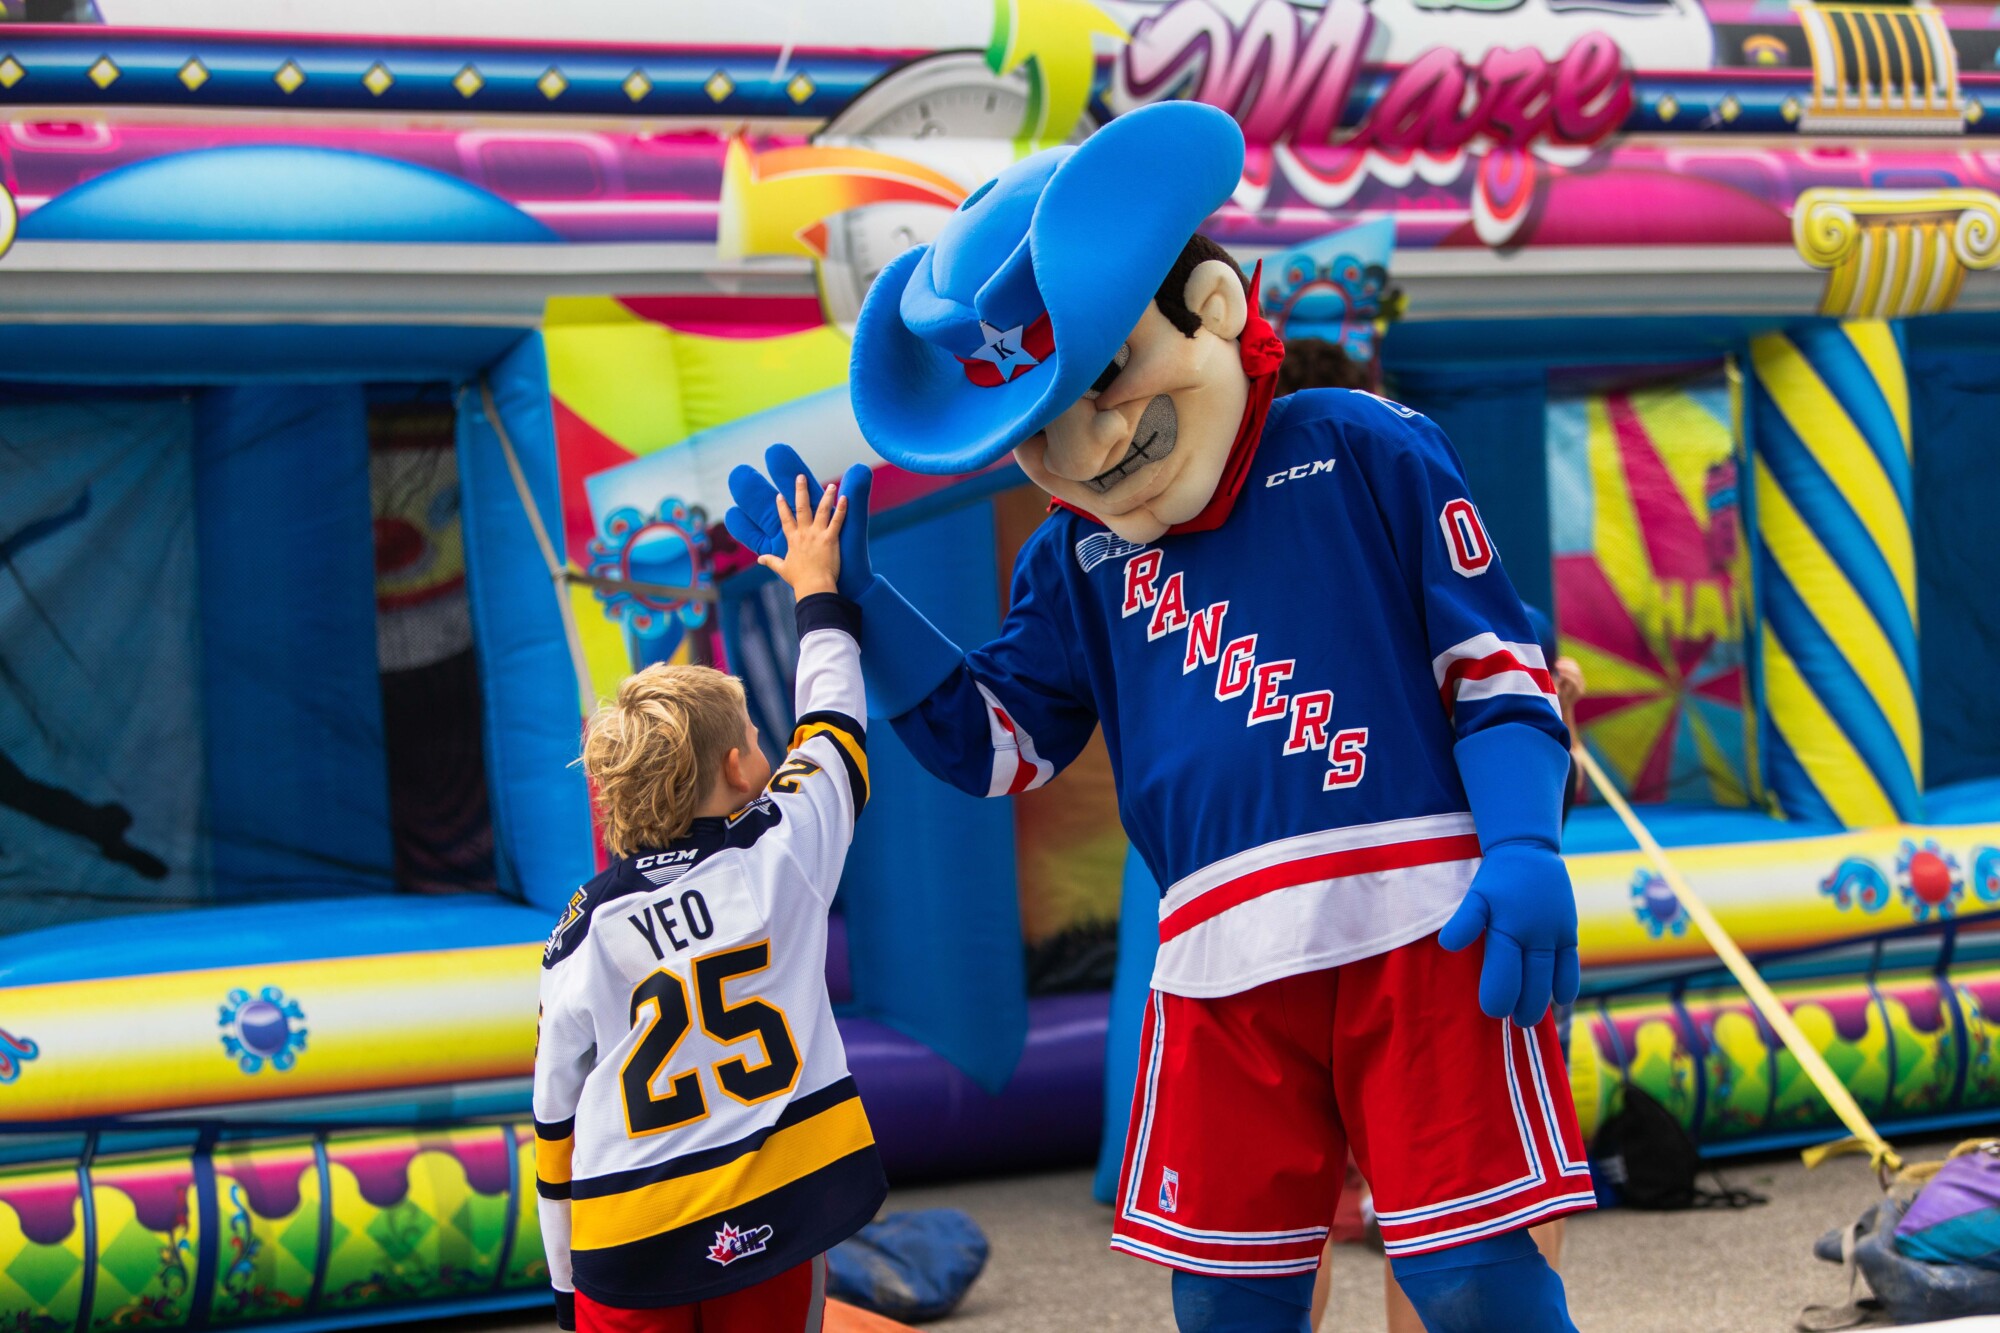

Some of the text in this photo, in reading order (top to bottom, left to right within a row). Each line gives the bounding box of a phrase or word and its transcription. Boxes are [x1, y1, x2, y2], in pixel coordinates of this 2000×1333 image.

[1115, 0, 1632, 230] Maze
[990, 338, 1016, 361] K
[1265, 459, 1336, 488] CCM
[1439, 498, 1493, 578] 0
[1122, 548, 1368, 792] RANGERS
[636, 849, 698, 870] CCM
[627, 890, 714, 961] YEO
[620, 939, 803, 1138] 25
